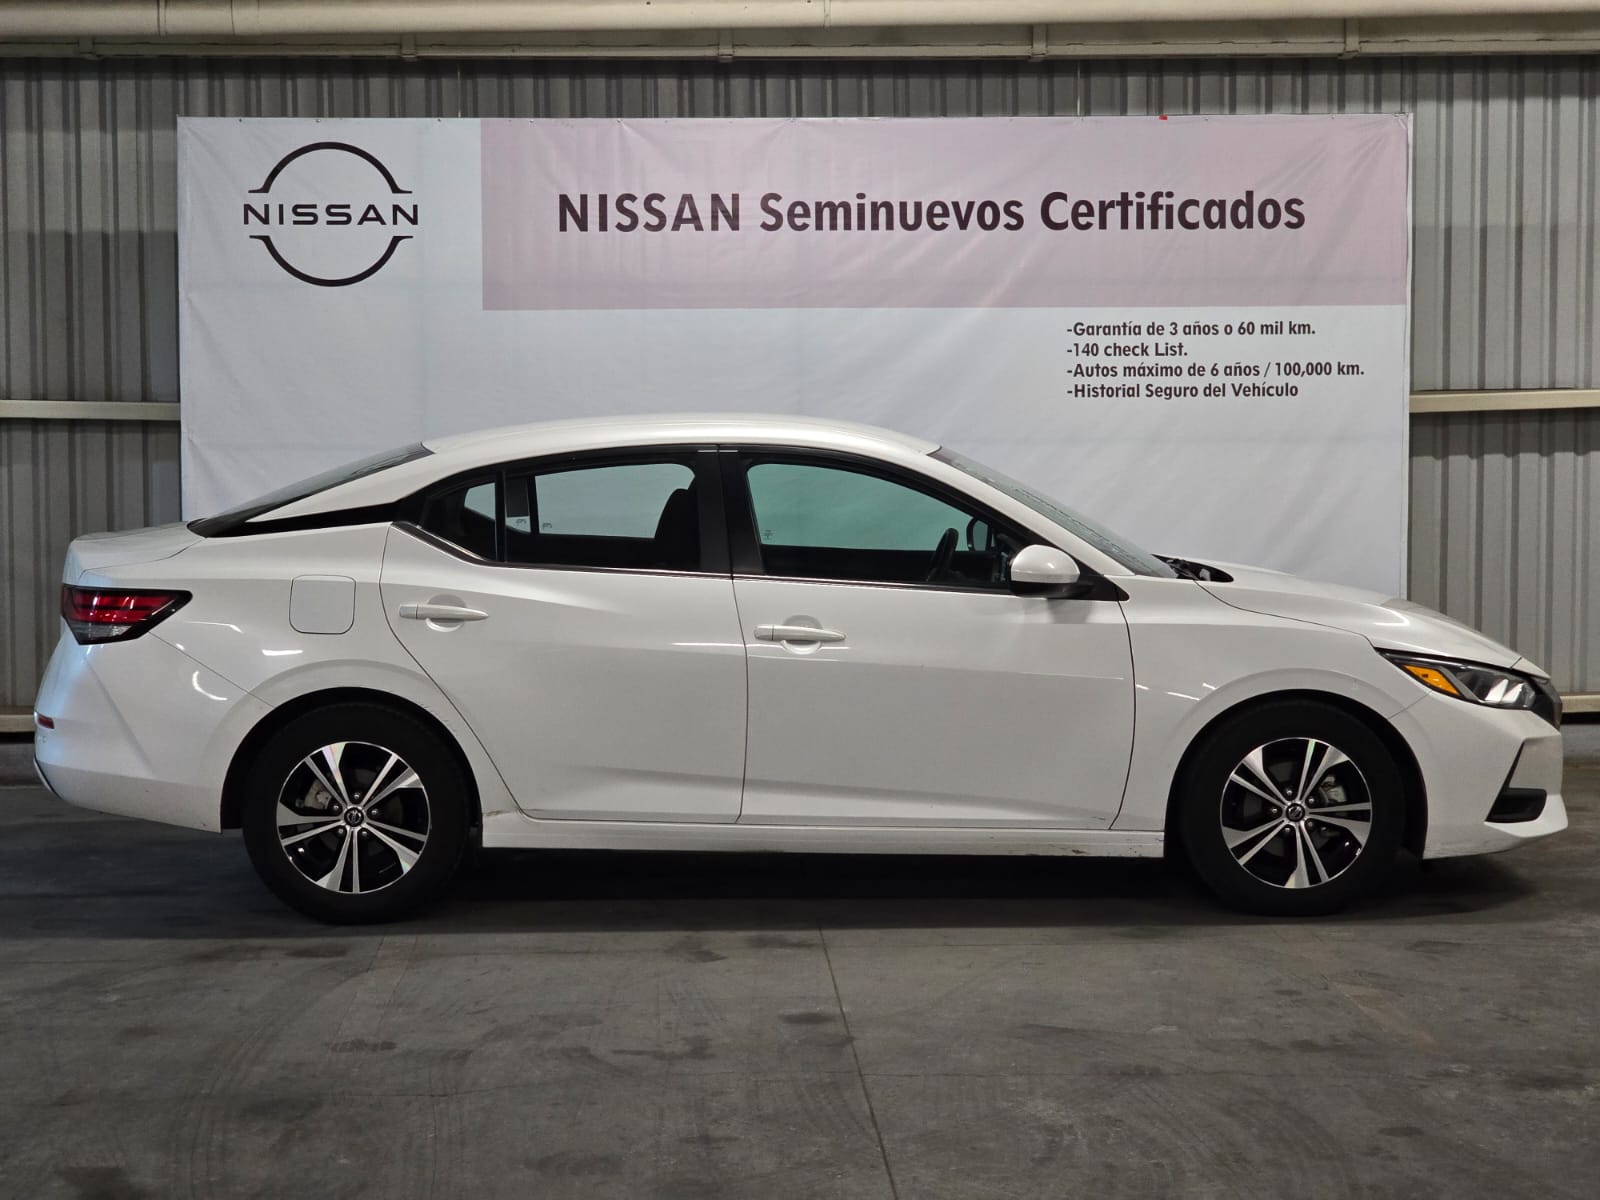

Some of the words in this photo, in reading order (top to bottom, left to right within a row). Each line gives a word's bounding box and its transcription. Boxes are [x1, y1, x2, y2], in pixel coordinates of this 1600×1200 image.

[243, 203, 418, 225] NISSAN
[559, 193, 739, 232] NISSAN
[760, 193, 1024, 231] Seminuevos
[1041, 190, 1305, 231] Certificados
[1066, 321, 1142, 337] -Garantía
[1146, 321, 1165, 336] de
[1169, 321, 1179, 336] 3
[1183, 320, 1220, 336] años
[1223, 323, 1234, 336] o
[1237, 321, 1256, 336] 60
[1259, 320, 1284, 336] mil
[1288, 320, 1316, 336] km.
[1066, 342, 1100, 357] -140
[1103, 341, 1150, 357] check
[1154, 341, 1189, 357] List.
[1066, 362, 1119, 378] -Autos
[1122, 361, 1184, 378] máximo
[1187, 361, 1207, 377] de
[1210, 362, 1220, 377] 6
[1336, 360, 1366, 376] km.
[1066, 383, 1141, 399] -Historial
[1144, 383, 1199, 401] Seguro
[1202, 382, 1226, 398] del
[1230, 381, 1299, 398] Vehículo
